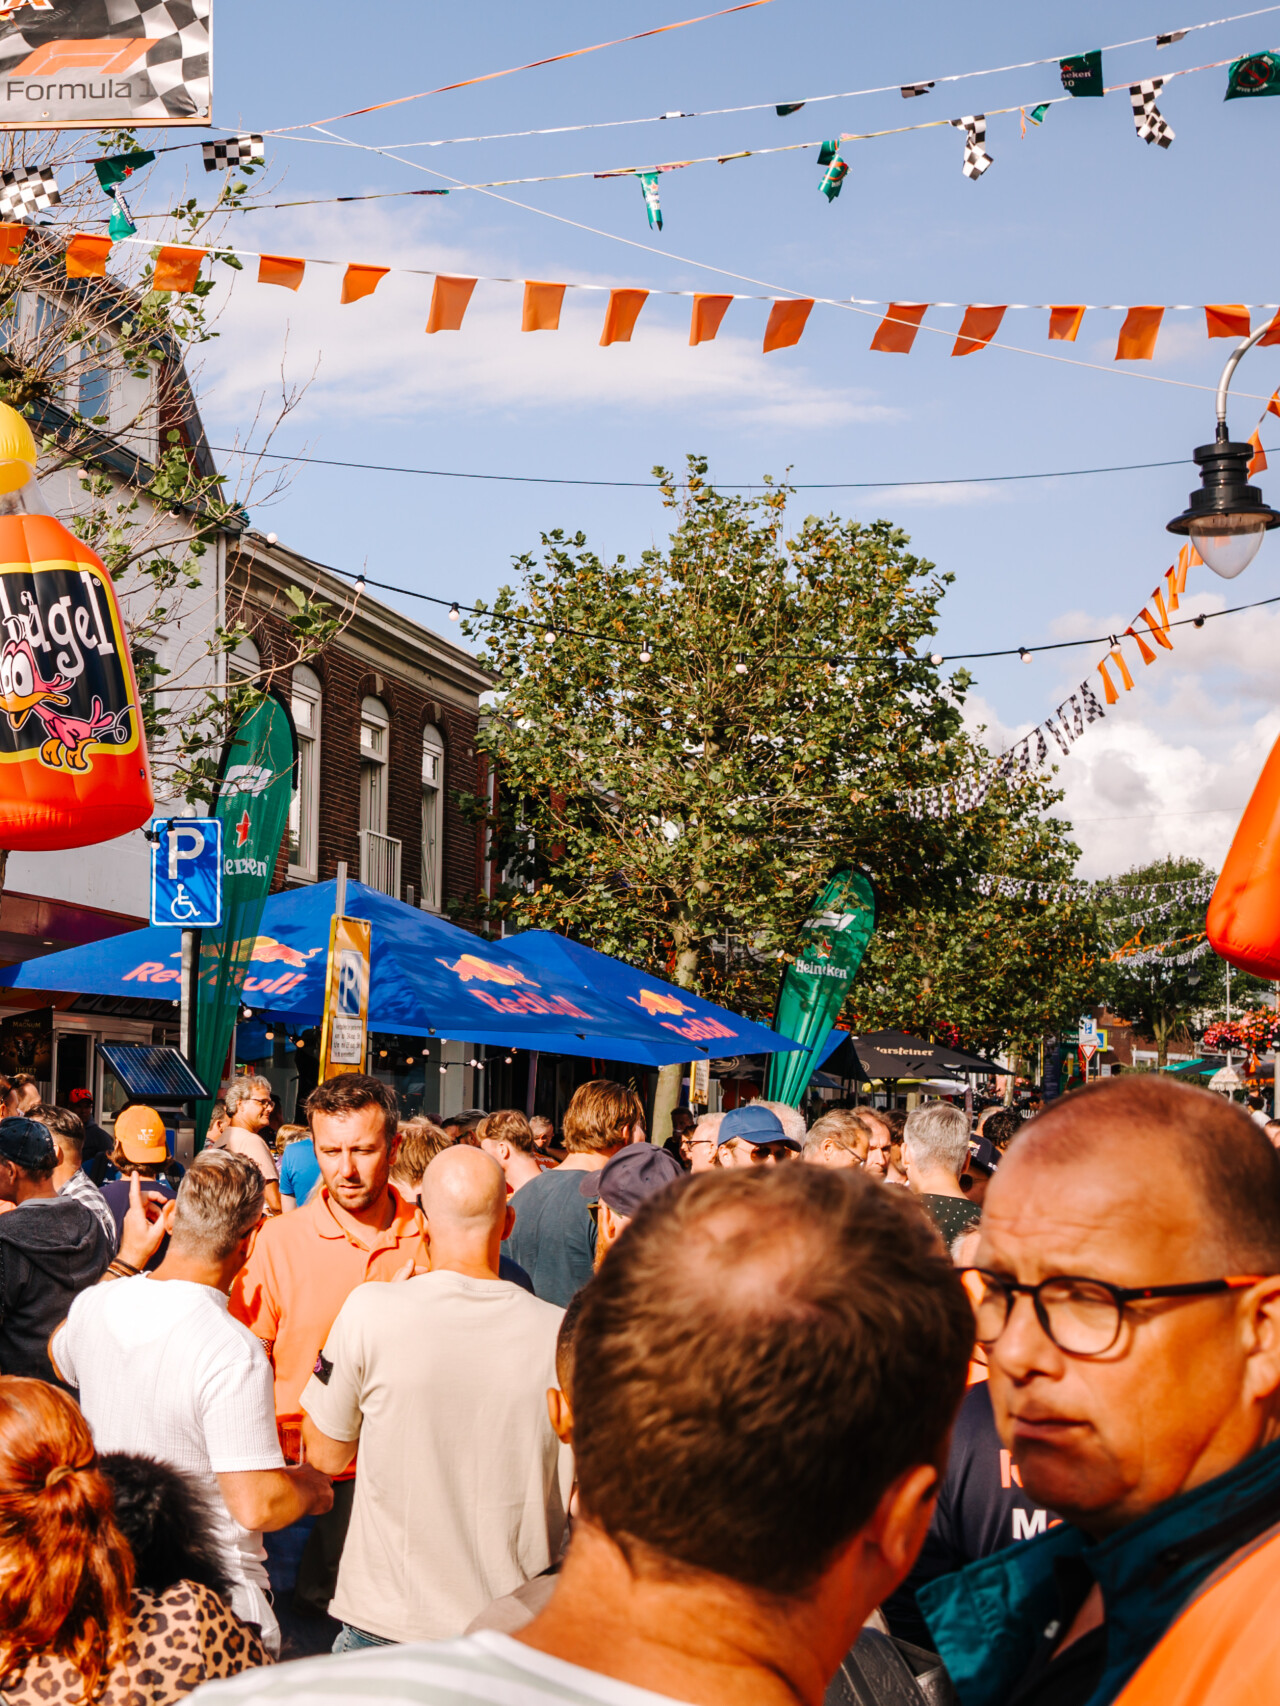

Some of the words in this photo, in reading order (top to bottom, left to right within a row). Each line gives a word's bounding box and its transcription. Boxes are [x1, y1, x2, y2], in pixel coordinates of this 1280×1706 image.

[7, 79, 131, 101] Formula
[167, 826, 206, 880] P
[342, 957, 357, 1008] P
[873, 1046, 935, 1058] arsteiner
